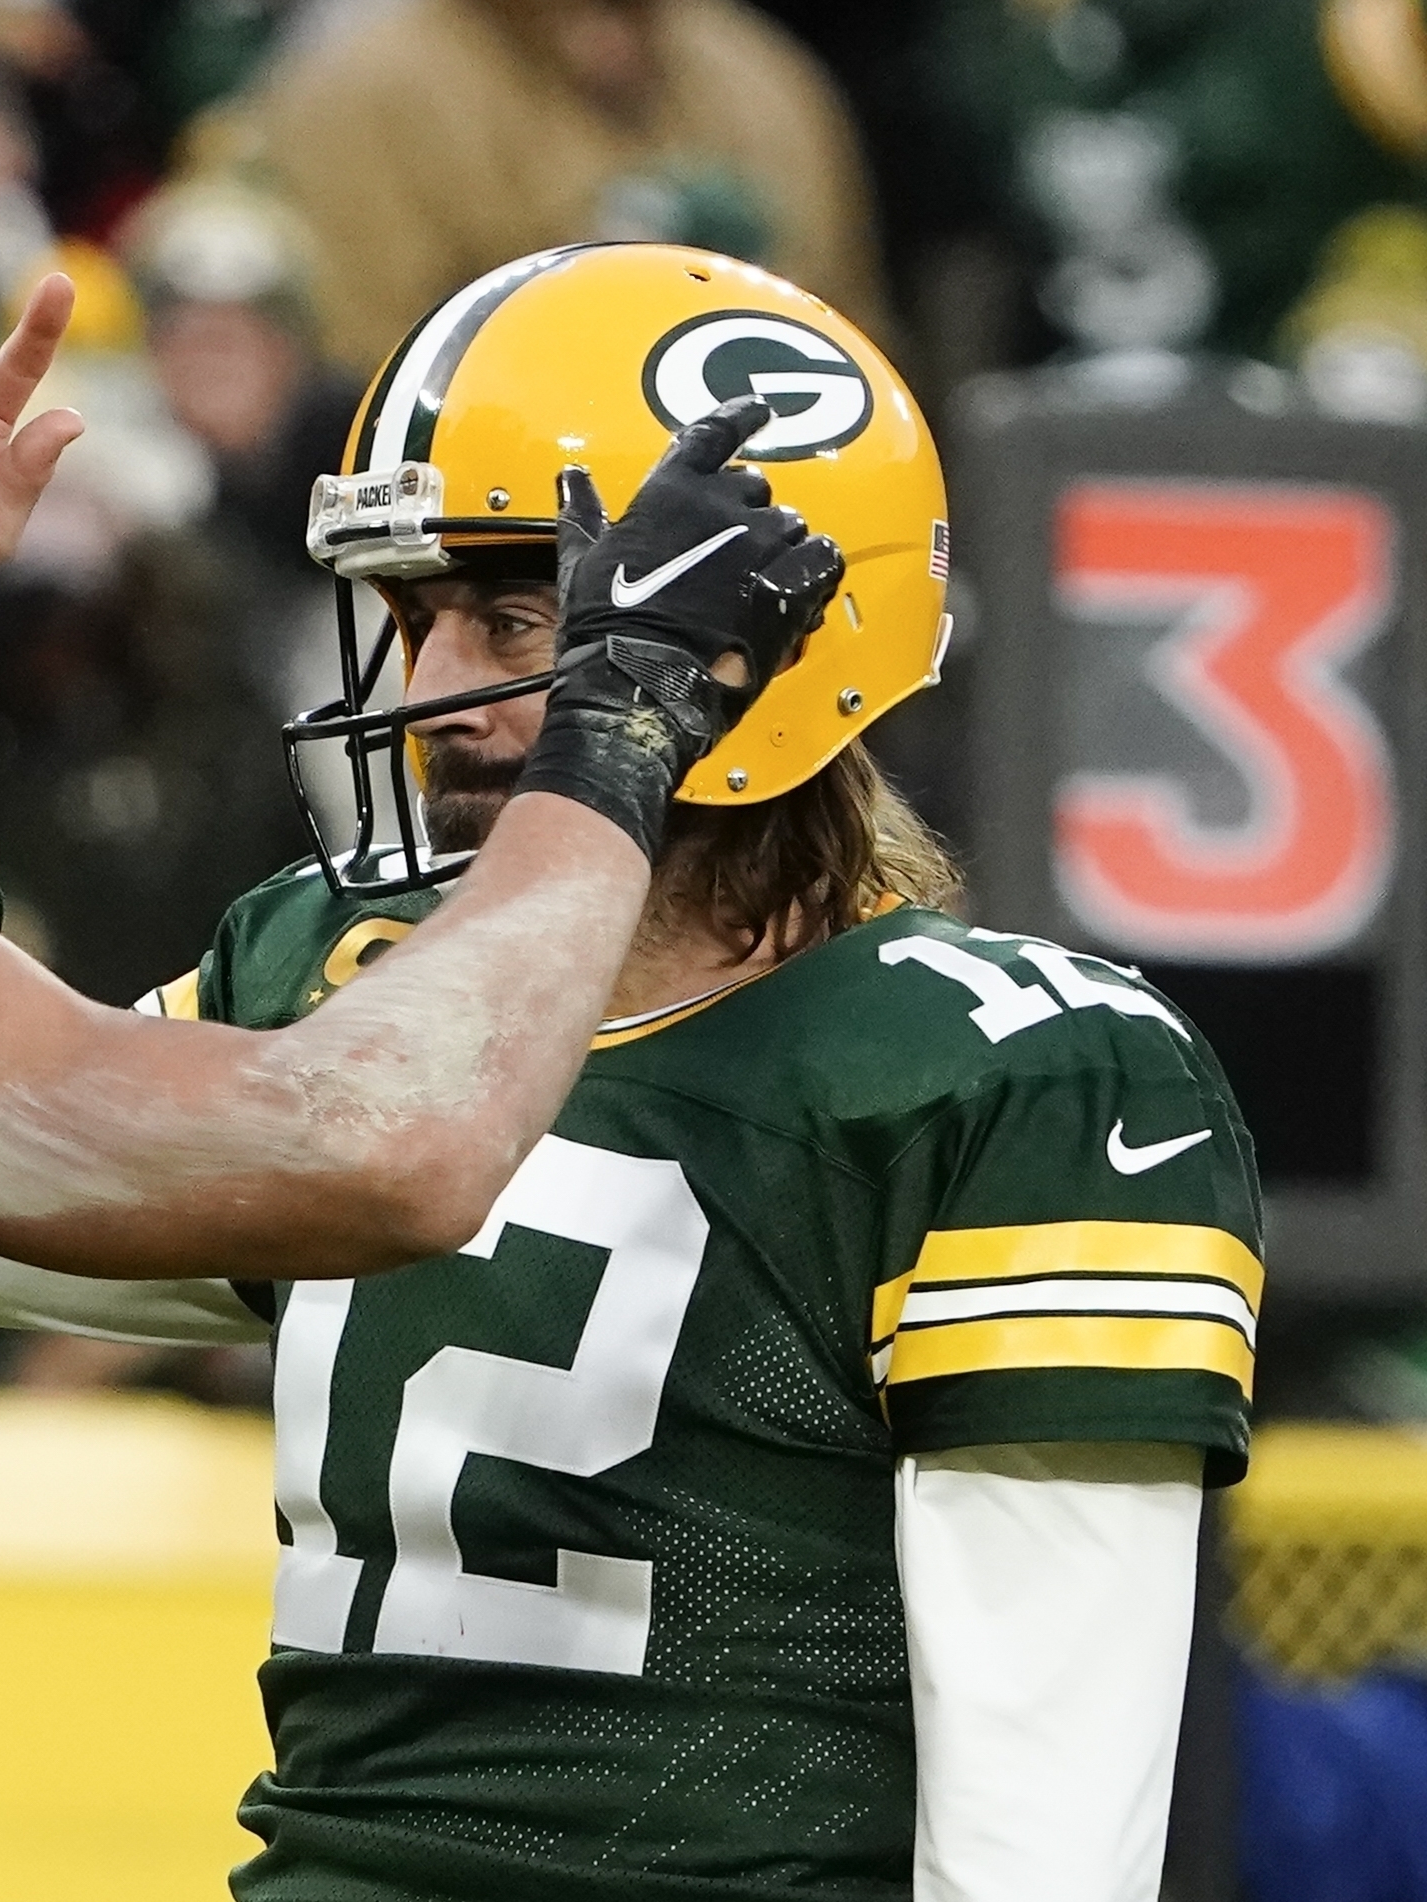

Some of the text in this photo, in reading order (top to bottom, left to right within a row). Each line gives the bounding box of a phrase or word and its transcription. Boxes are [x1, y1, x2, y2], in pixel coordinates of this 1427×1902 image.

[652, 315, 869, 453] G
[1051, 477, 1399, 960] 3
[272, 1133, 710, 1676] 12
